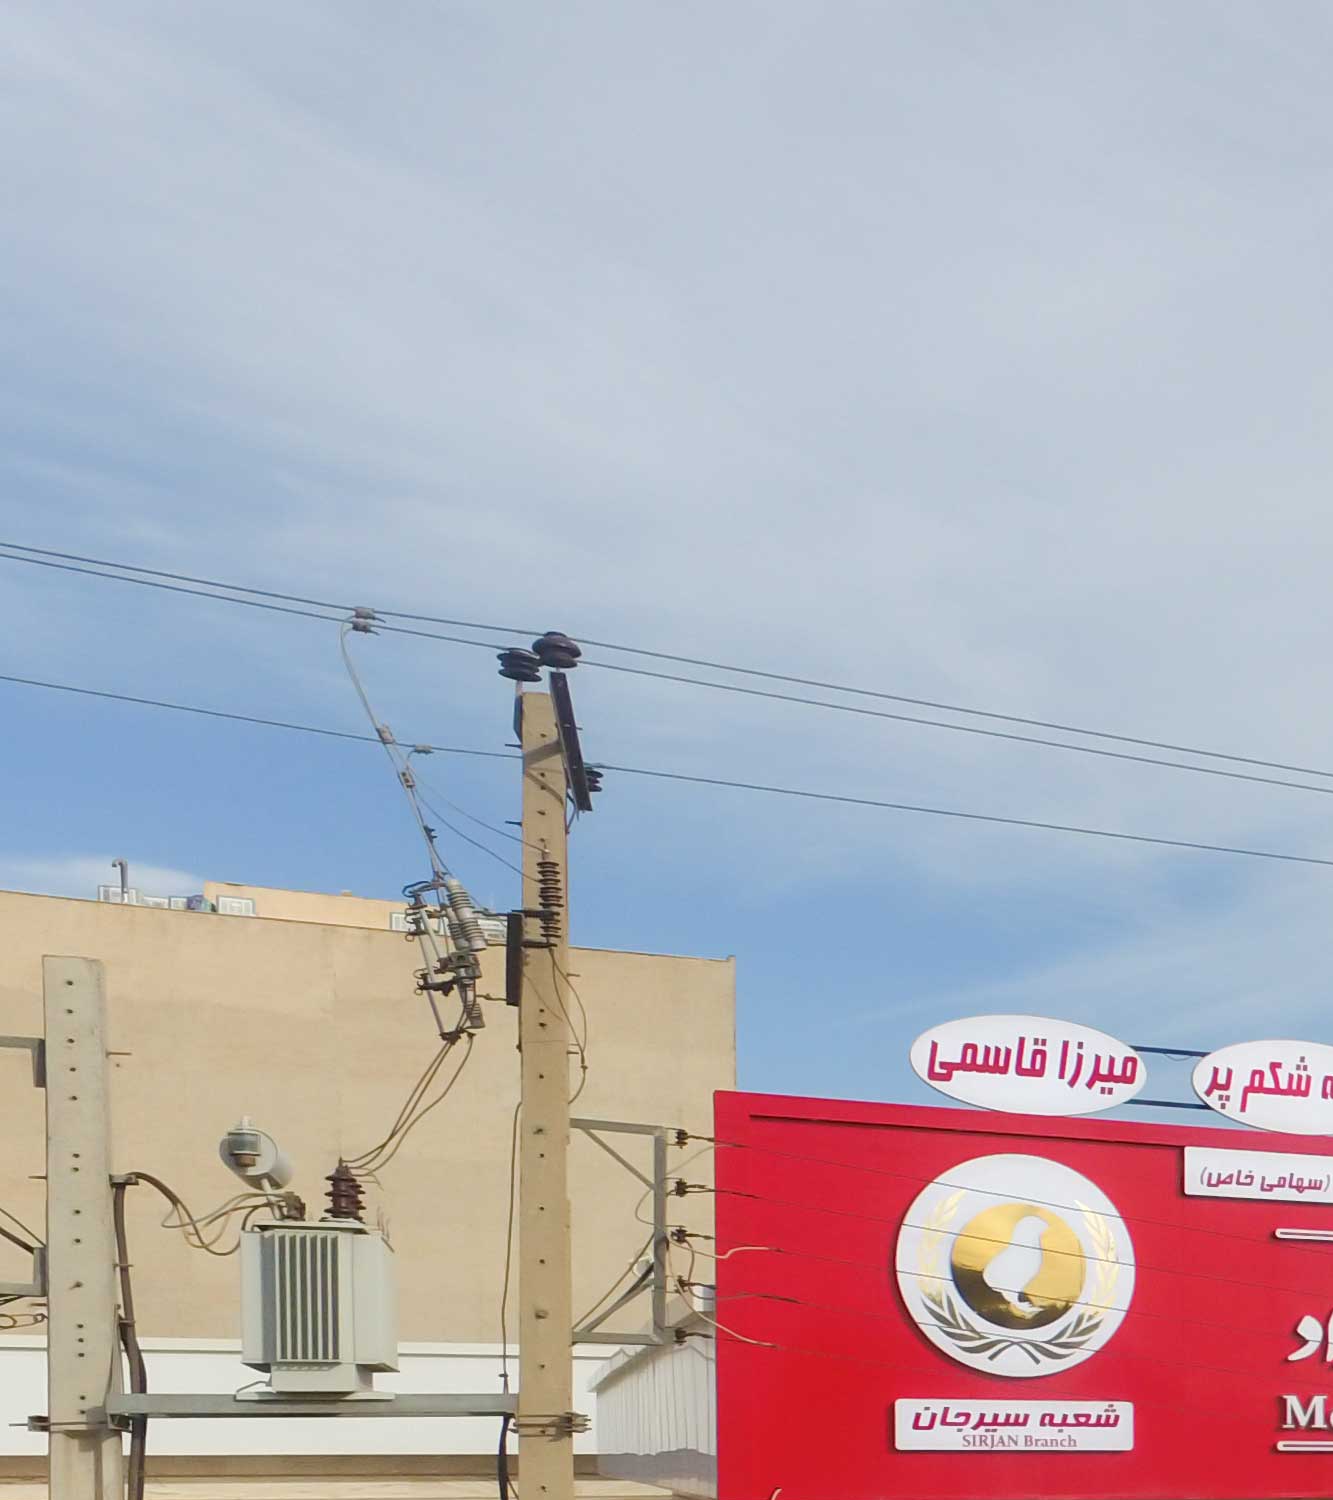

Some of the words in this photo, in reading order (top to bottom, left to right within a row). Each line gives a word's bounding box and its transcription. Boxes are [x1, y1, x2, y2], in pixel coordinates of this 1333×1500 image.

[927, 1035, 1049, 1083] قاسمی
[1057, 1038, 1138, 1095] میرزا
[1203, 1064, 1233, 1110] پر
[1239, 1055, 1312, 1113] شکم
[912, 1406, 1030, 1433] سیرجان
[1039, 1403, 1120, 1433] شعبه
[962, 1434, 1020, 1449] SIRJAN
[1024, 1435, 1077, 1448] Branch
